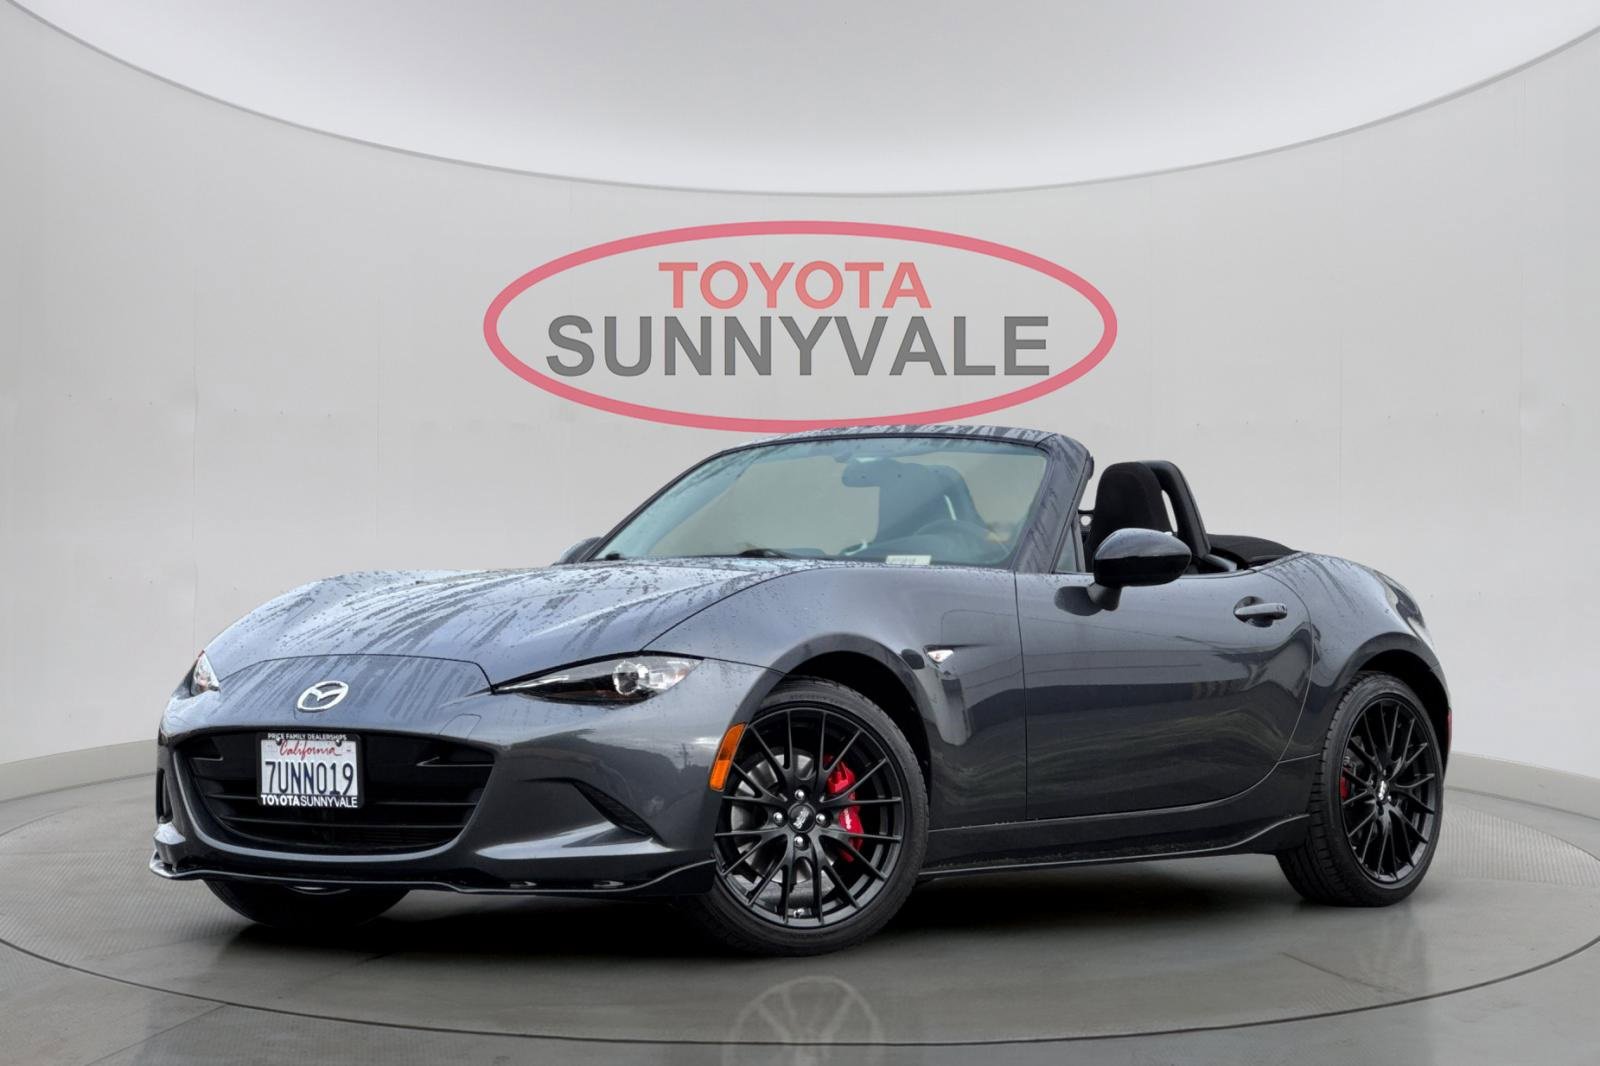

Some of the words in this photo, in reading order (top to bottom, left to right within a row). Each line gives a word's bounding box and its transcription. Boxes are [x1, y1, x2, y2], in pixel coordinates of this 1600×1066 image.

[658, 260, 932, 309] TOYOTA
[546, 314, 1050, 377] SUNNYVALE
[279, 739, 343, 761] California
[265, 761, 354, 795] 7UNN019
